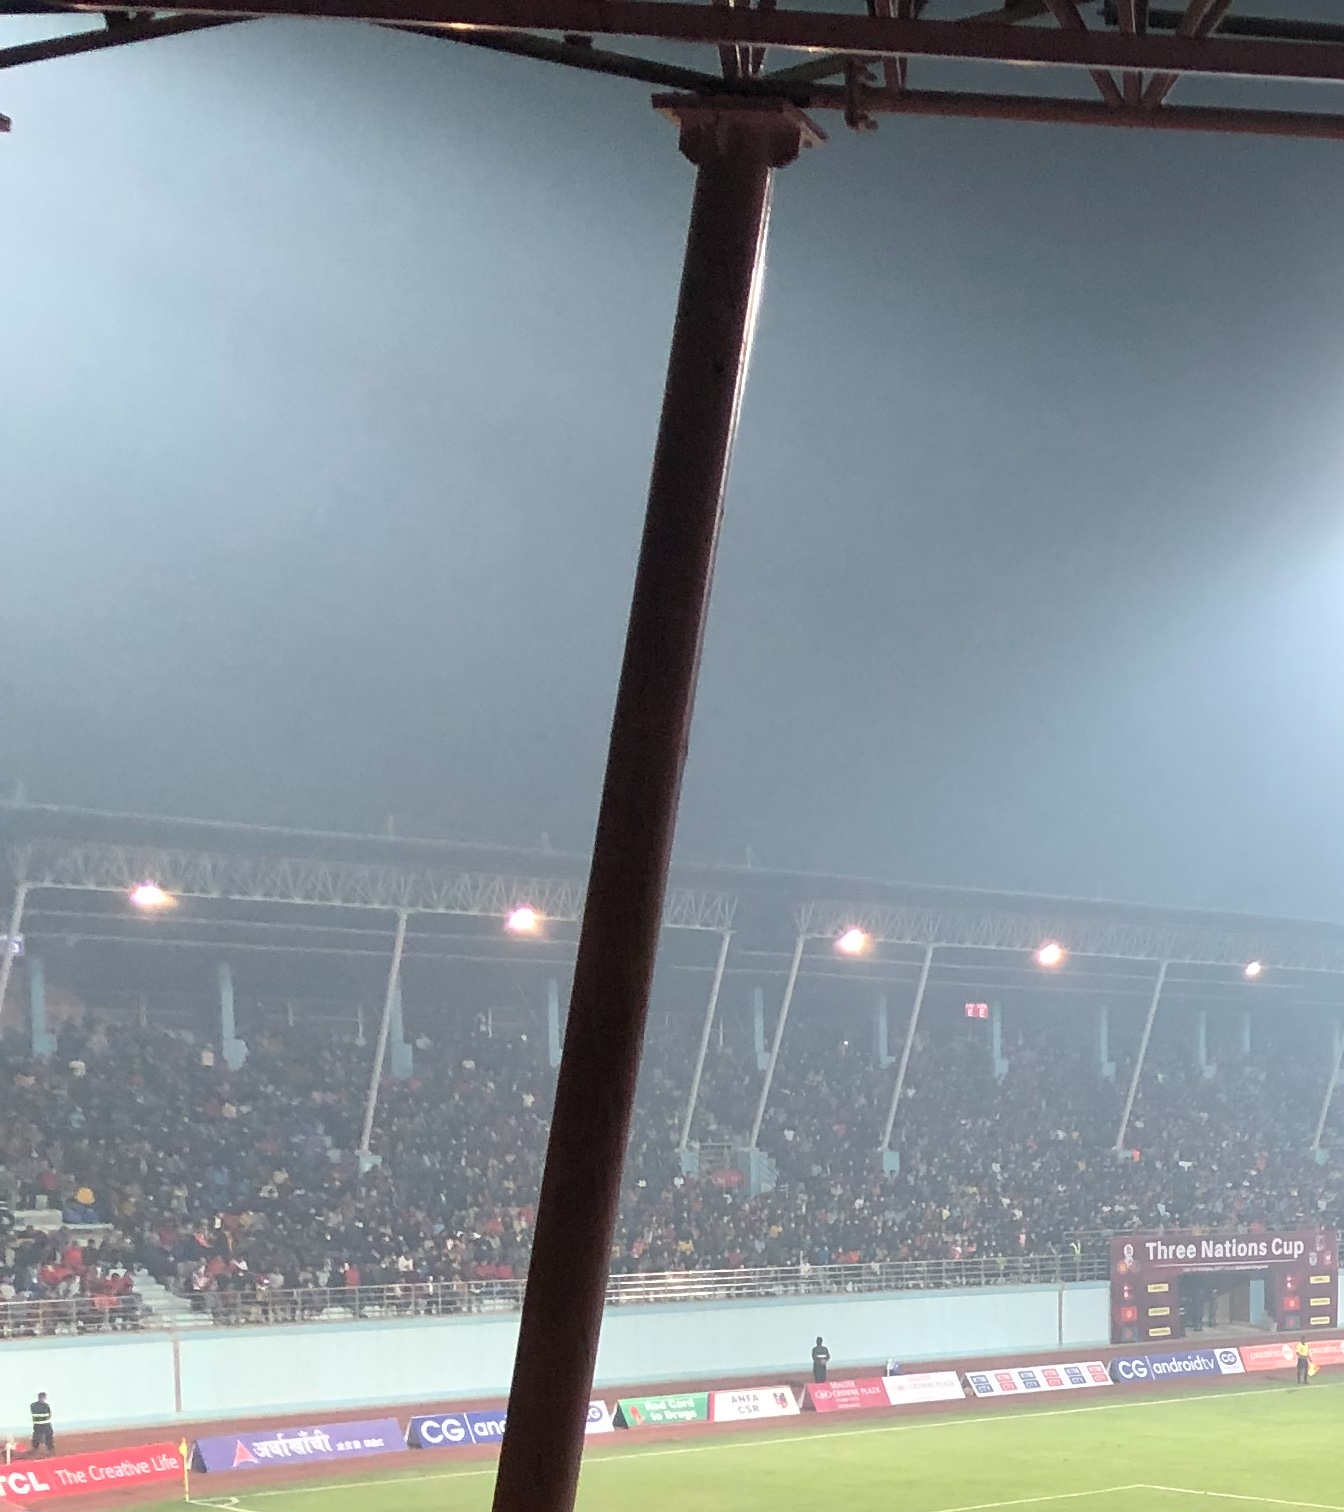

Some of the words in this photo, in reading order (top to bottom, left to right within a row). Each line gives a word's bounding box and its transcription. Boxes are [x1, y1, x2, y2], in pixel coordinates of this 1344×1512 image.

[1145, 1242, 1197, 1260] Three
[1201, 1239, 1268, 1258] Nations
[1271, 1237, 1305, 1258] Cup
[1221, 1353, 1236, 1363] CG
[1118, 1359, 1148, 1379] CG
[1152, 1355, 1215, 1375] androidtv
[860, 1386, 881, 1396] PLAZA
[644, 1400, 667, 1412] Red
[668, 1397, 696, 1409] Card
[731, 1393, 760, 1404] ANFA
[650, 1411, 664, 1422] to
[665, 1409, 698, 1422] Drugs
[737, 1404, 760, 1414] CSR
[420, 1418, 466, 1444] CG
[0, 1471, 50, 1497] TCL
[55, 1469, 87, 1486] The
[88, 1459, 151, 1481] Creative
[151, 1453, 180, 1472] Life
